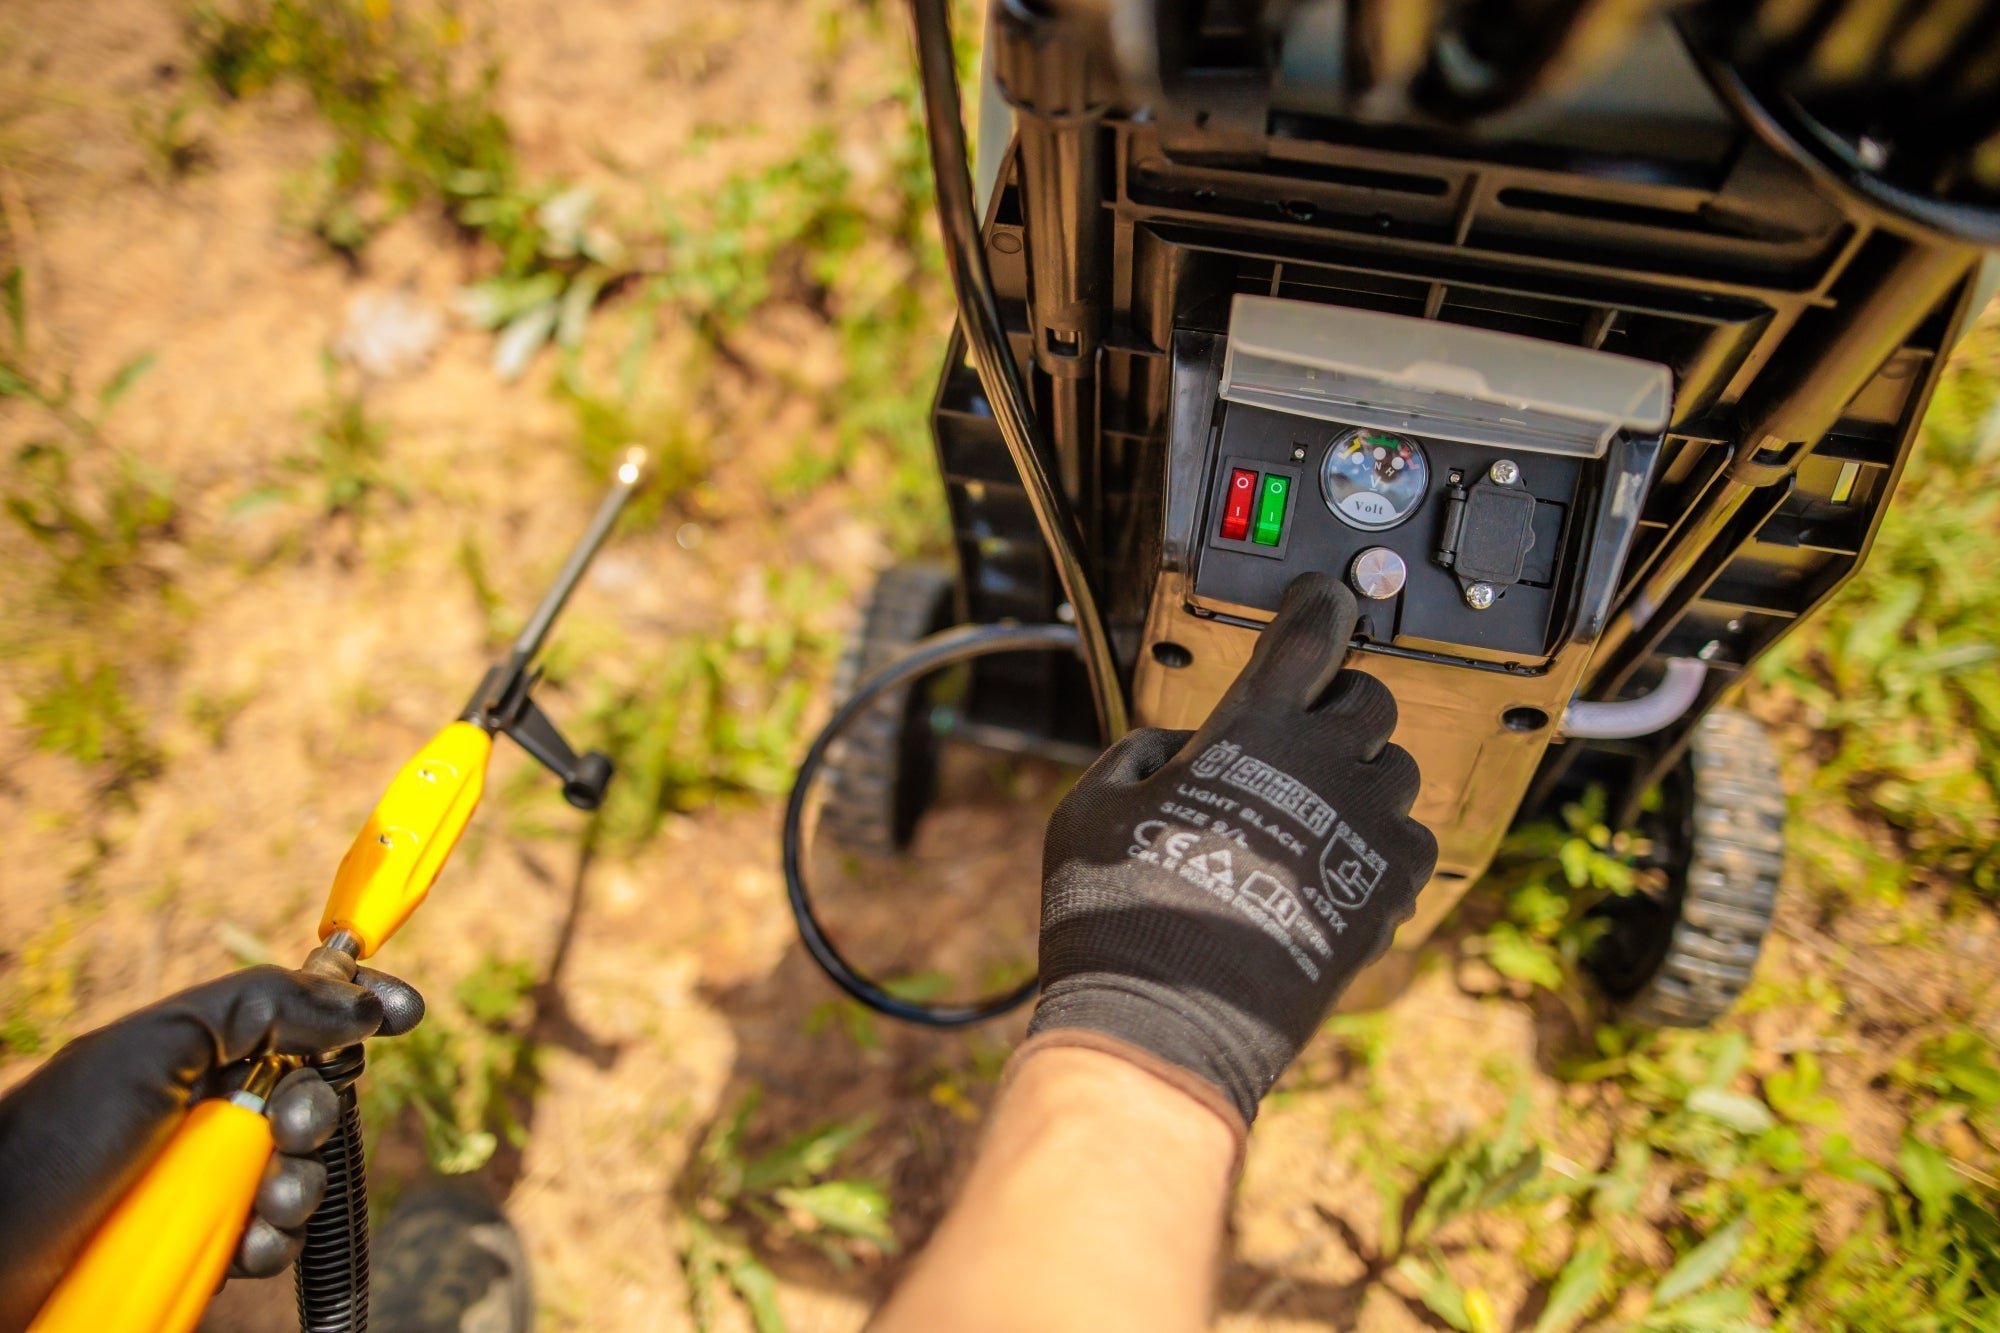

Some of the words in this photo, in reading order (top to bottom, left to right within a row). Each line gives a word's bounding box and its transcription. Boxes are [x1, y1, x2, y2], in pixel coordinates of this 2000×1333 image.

[1374, 461, 1383, 470] N
[1355, 500, 1383, 515] Volt
[1160, 801, 1211, 827] SIZE
[1176, 783, 1241, 812] LIGHT
[1239, 807, 1307, 857] BLACK
[1302, 886, 1349, 935] 4131X
